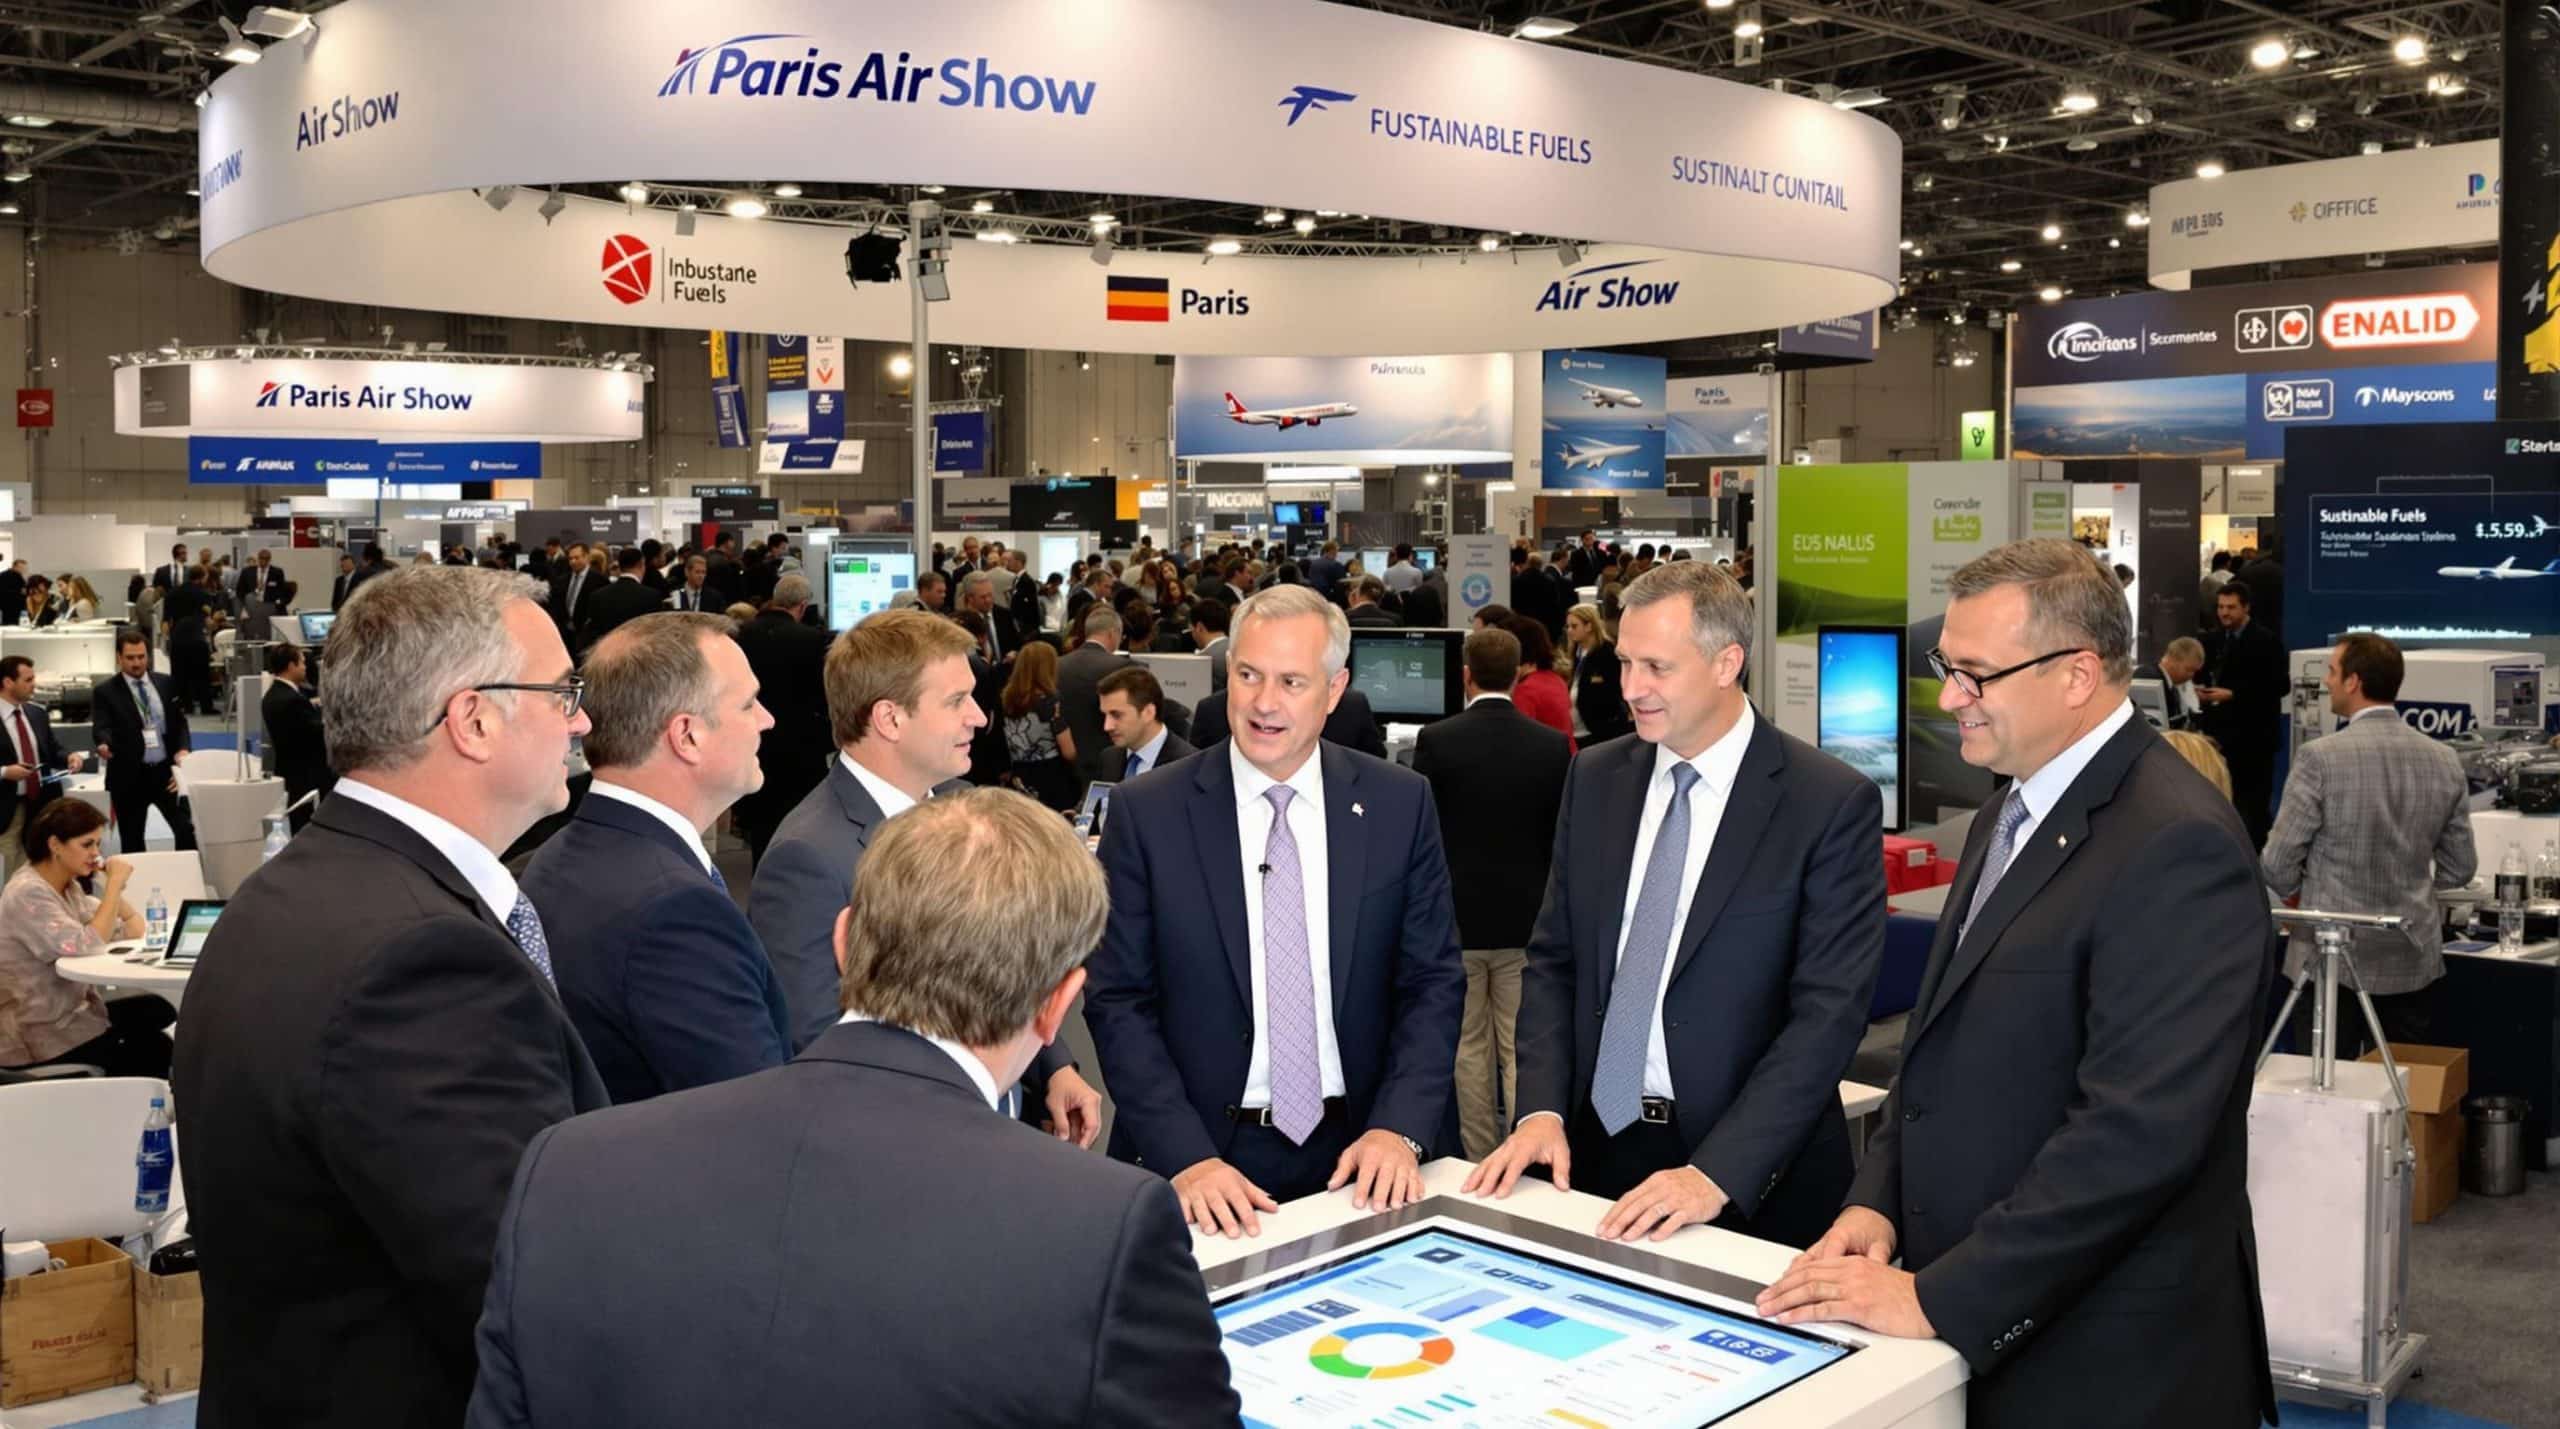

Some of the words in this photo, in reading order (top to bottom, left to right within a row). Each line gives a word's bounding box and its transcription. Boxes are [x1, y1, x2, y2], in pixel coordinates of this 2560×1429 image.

[709, 47, 842, 98] Paris
[848, 52, 933, 103] Air
[938, 58, 1096, 116] Show
[296, 111, 328, 152] Air
[332, 91, 400, 136] Show
[1370, 108, 1524, 157] FUSTAINABLE
[1529, 131, 1593, 165] FUELS
[1672, 155, 1769, 195] SUSTINALT
[669, 257, 757, 284] Inbustane
[1181, 288, 1249, 315] Paris
[1535, 279, 1592, 312] Air
[1597, 276, 1680, 310] Show
[2333, 307, 2456, 337] ENALID
[289, 383, 351, 409] Paris
[357, 386, 397, 410] Air
[403, 387, 473, 412] Show
[2381, 387, 2455, 406] Mayscons
[2391, 507, 2427, 523] Fuels
